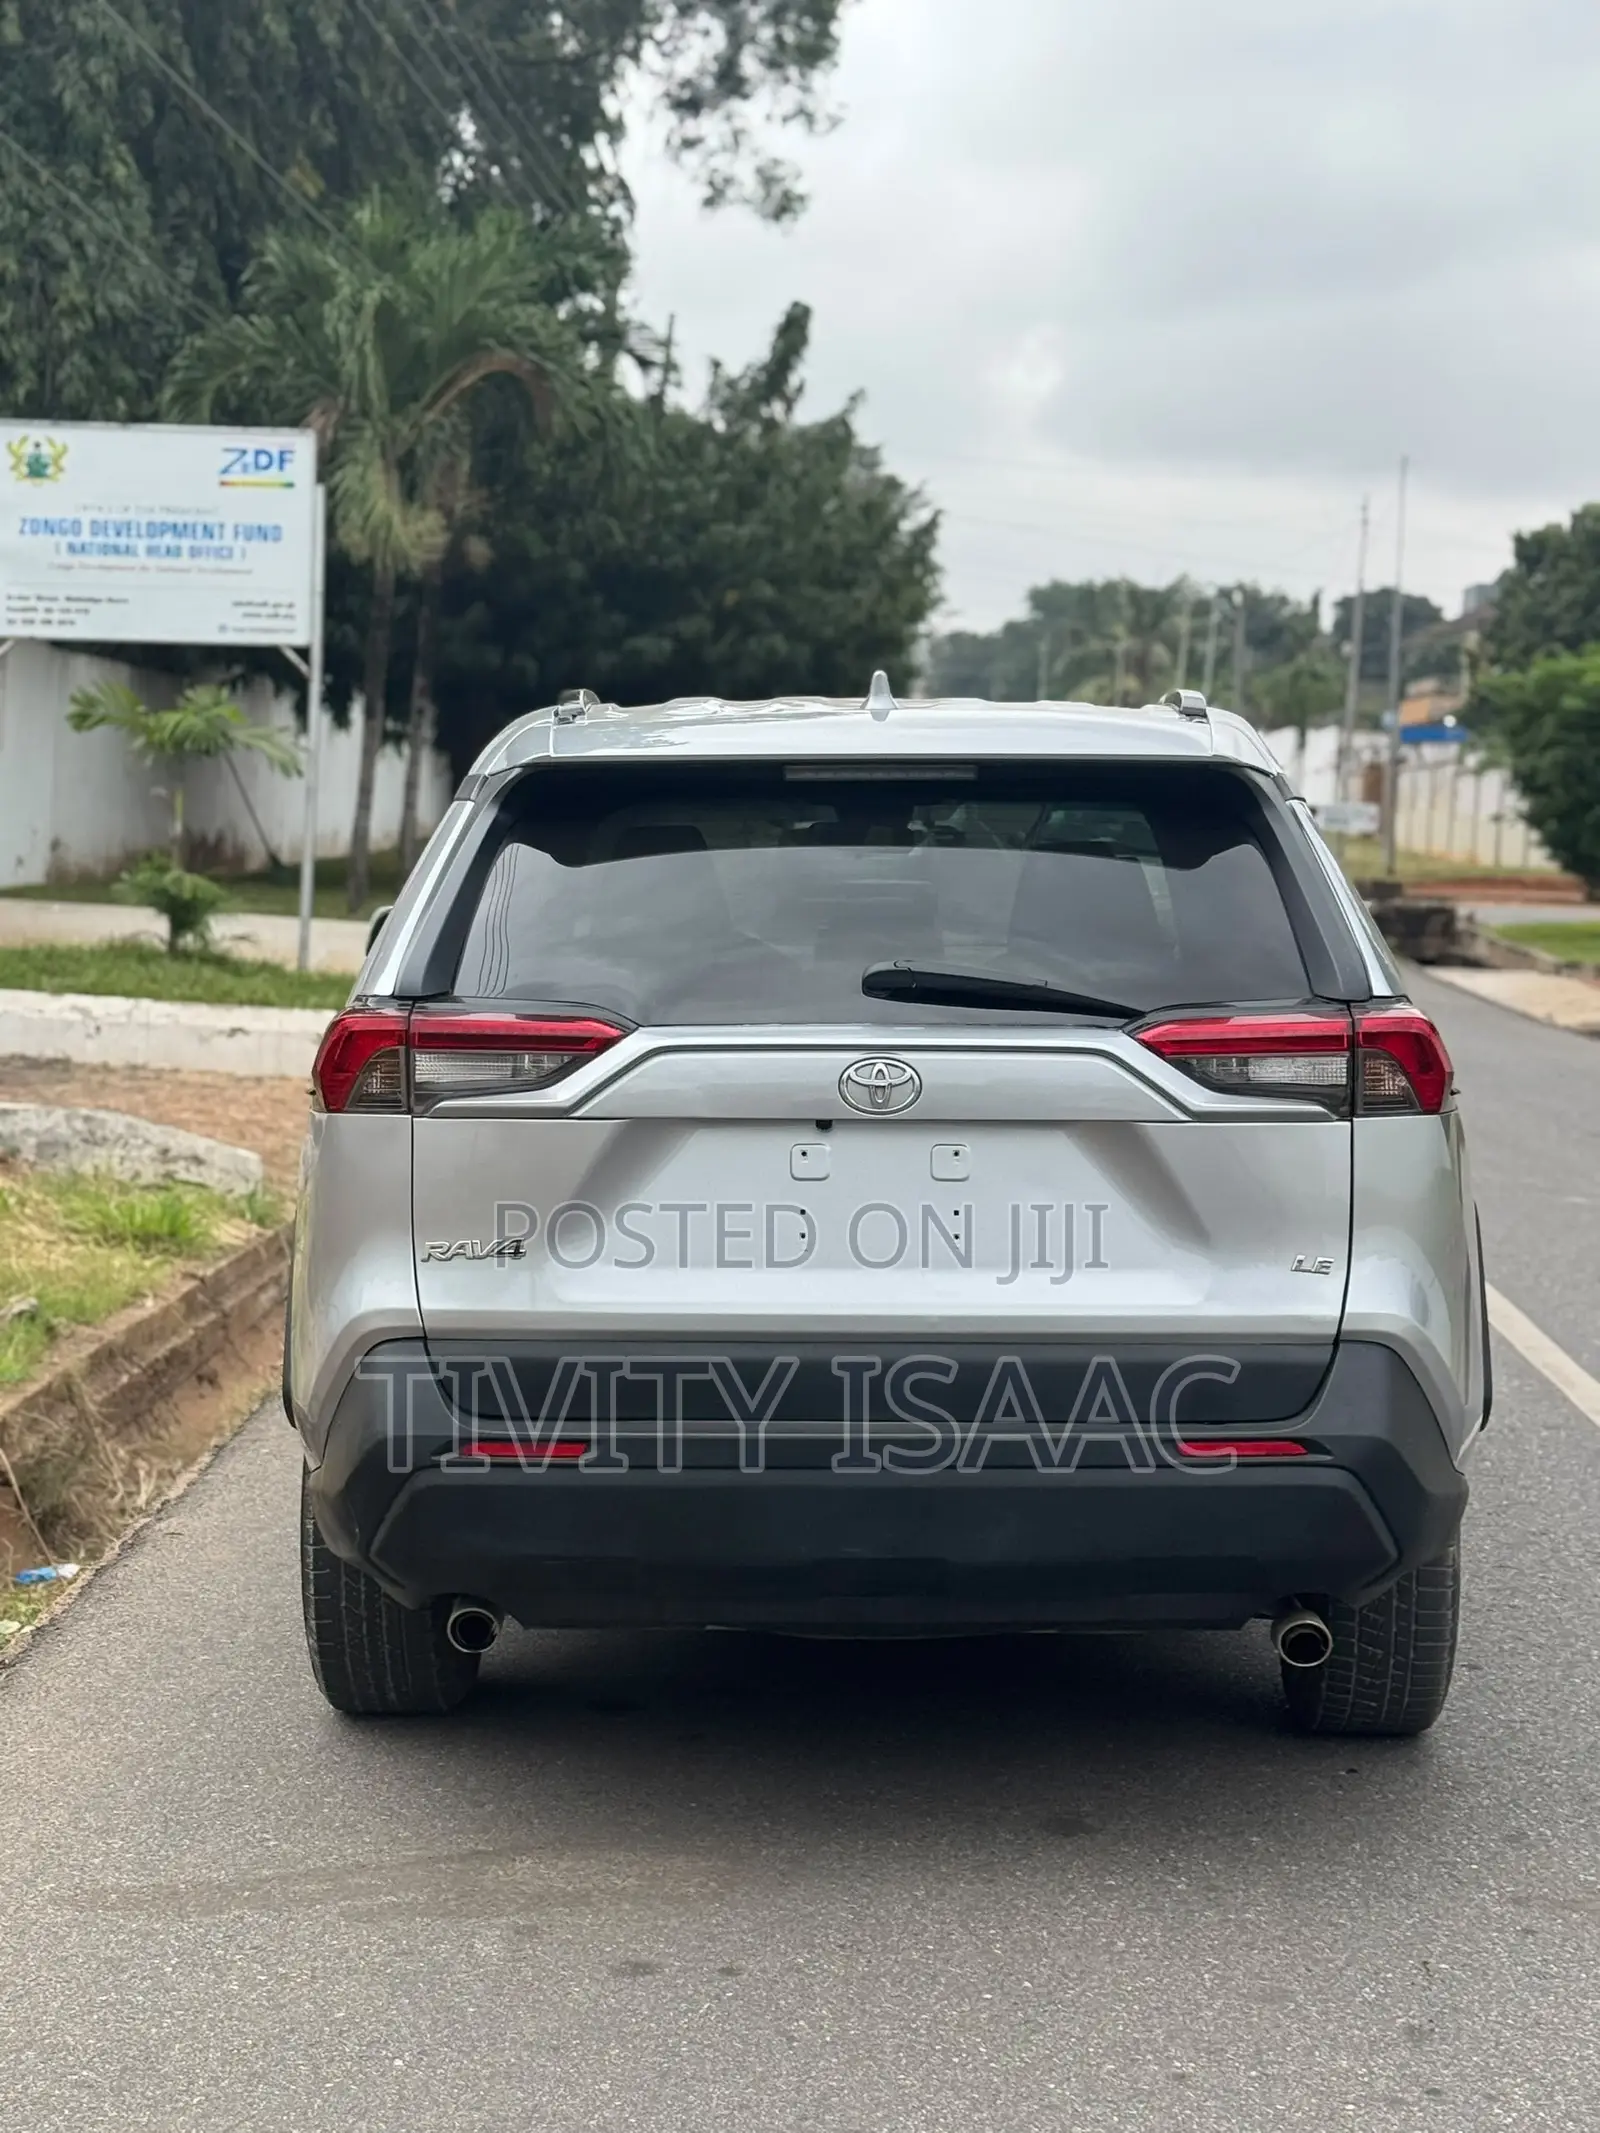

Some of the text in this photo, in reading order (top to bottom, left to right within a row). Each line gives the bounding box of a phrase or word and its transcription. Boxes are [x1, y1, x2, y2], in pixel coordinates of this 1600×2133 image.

[219, 447, 297, 475] ZDF
[19, 517, 283, 543] ZONGO DEVELOPMENT FUND
[421, 1237, 527, 1262] RAV4
[1290, 1254, 1335, 1275] LE
